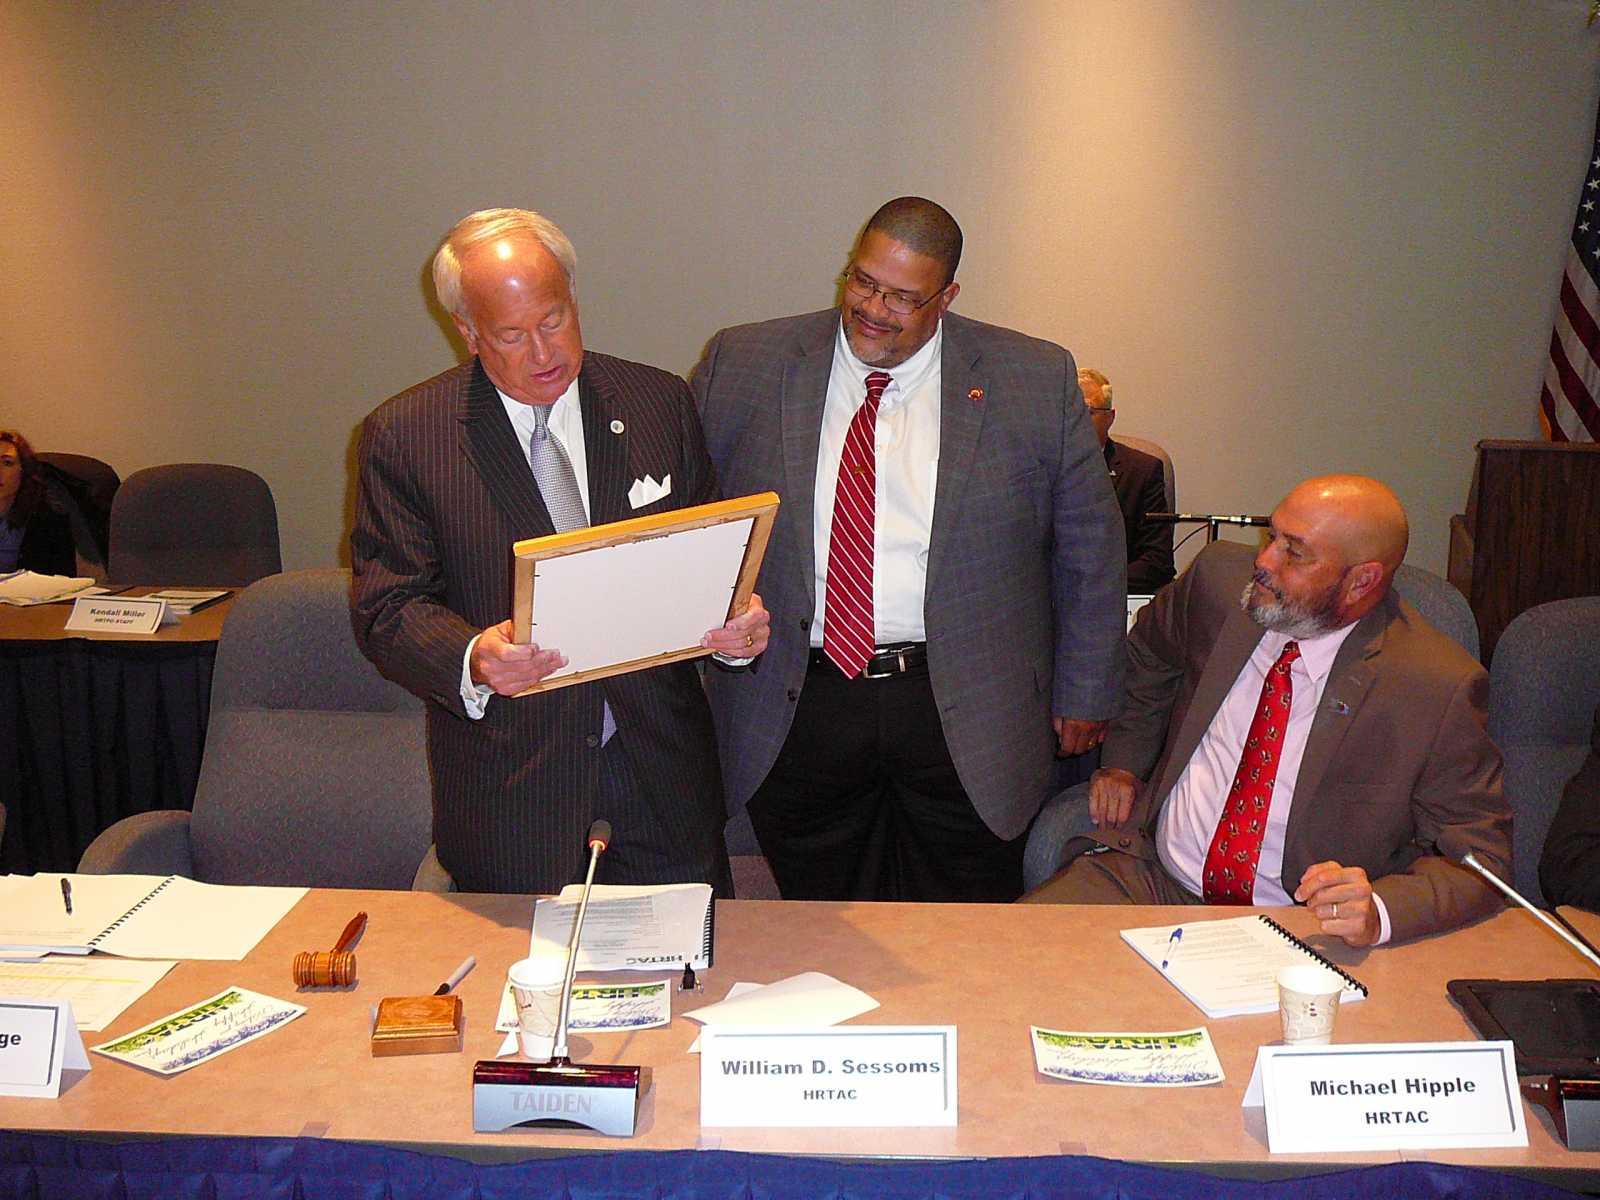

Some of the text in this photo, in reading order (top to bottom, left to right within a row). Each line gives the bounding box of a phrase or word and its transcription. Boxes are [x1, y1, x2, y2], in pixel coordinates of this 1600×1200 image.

[90, 608, 146, 618] Kendall Miller
[721, 1058, 941, 1076] William D. Sessoms
[803, 1089, 858, 1101] HRTAC
[1310, 1077, 1477, 1098] Michael Hipple
[511, 1091, 592, 1114] TAIDEN
[1364, 1110, 1430, 1125] HRTAC
